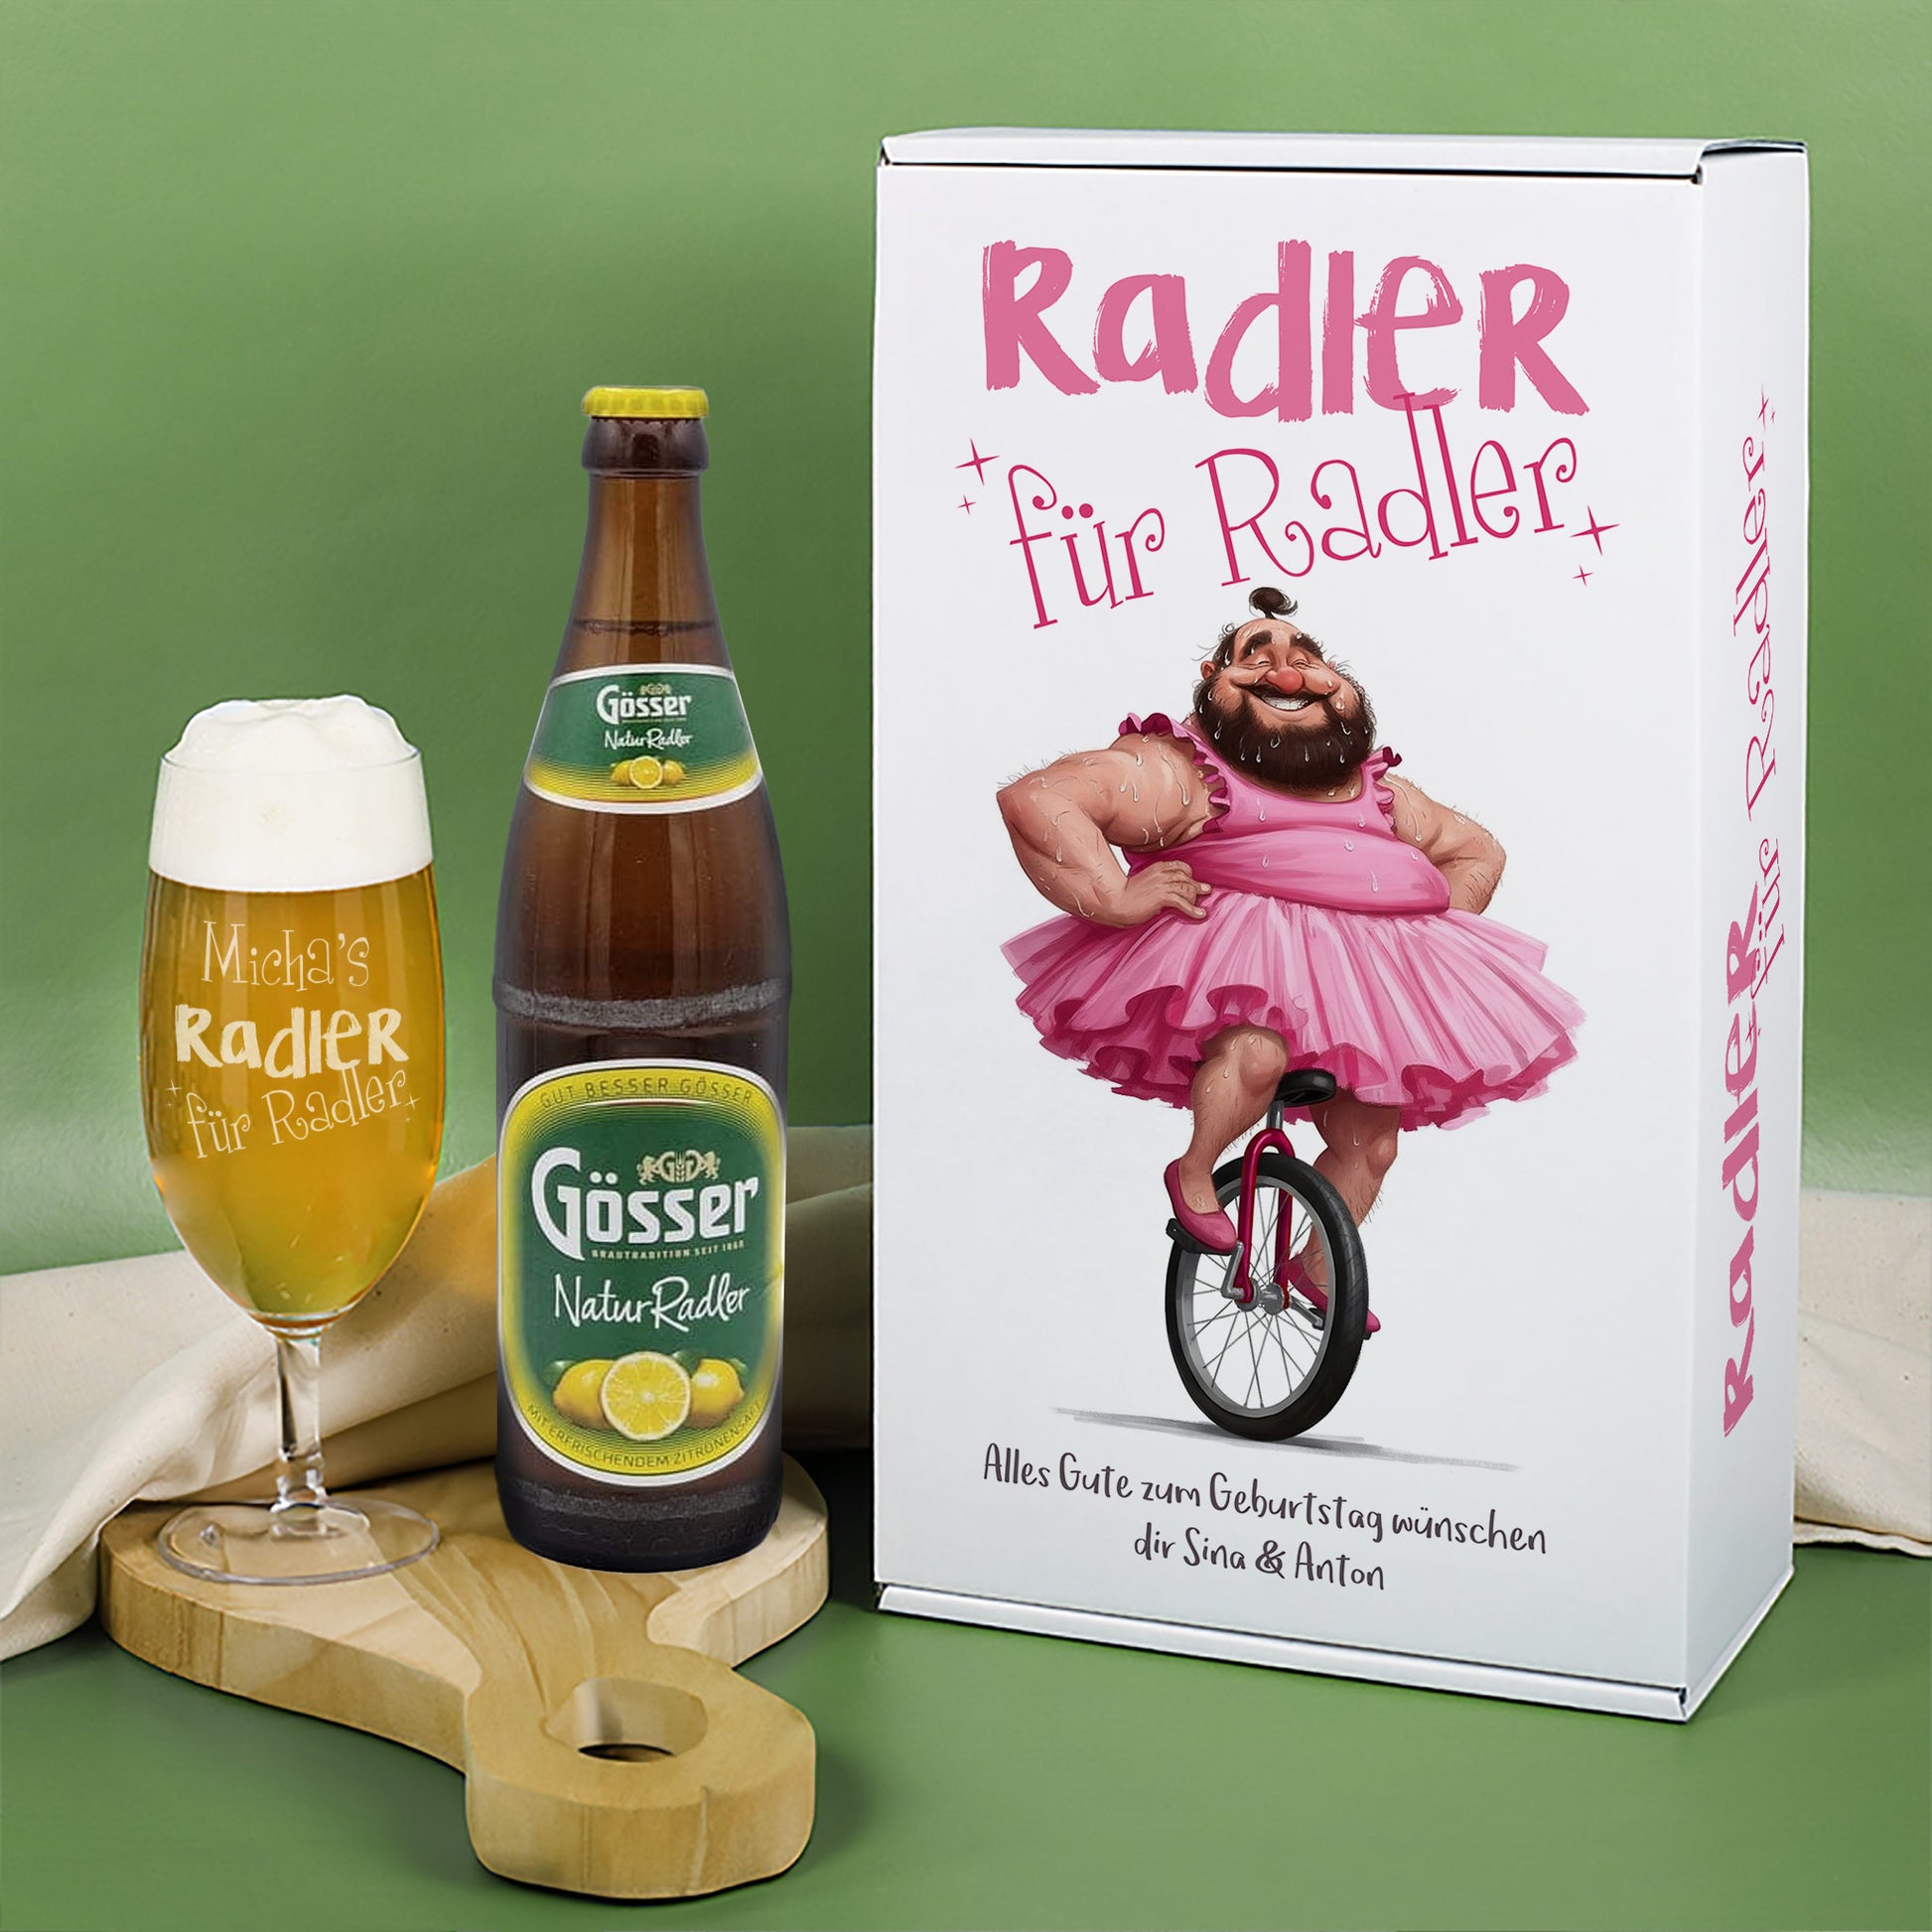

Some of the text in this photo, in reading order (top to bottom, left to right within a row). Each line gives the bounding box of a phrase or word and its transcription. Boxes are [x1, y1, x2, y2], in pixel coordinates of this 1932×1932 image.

[1007, 391, 1579, 629] für Radler
[597, 684, 691, 725] Gösser
[1732, 435, 1785, 1000] für Radler
[201, 920, 370, 992] Micha's
[186, 1067, 407, 1160] für Radler
[539, 1076, 754, 1110] GUT BESSER GÖSSER
[531, 1147, 759, 1262] Gösser
[695, 1245, 719, 1256] SEIT
[548, 1430, 670, 1467] ERFRISCHENDEM
[983, 1443, 1547, 1555] Alles Gute zum Geburtstag wünschen
[1133, 1521, 1386, 1590] dir Sina & Anton
